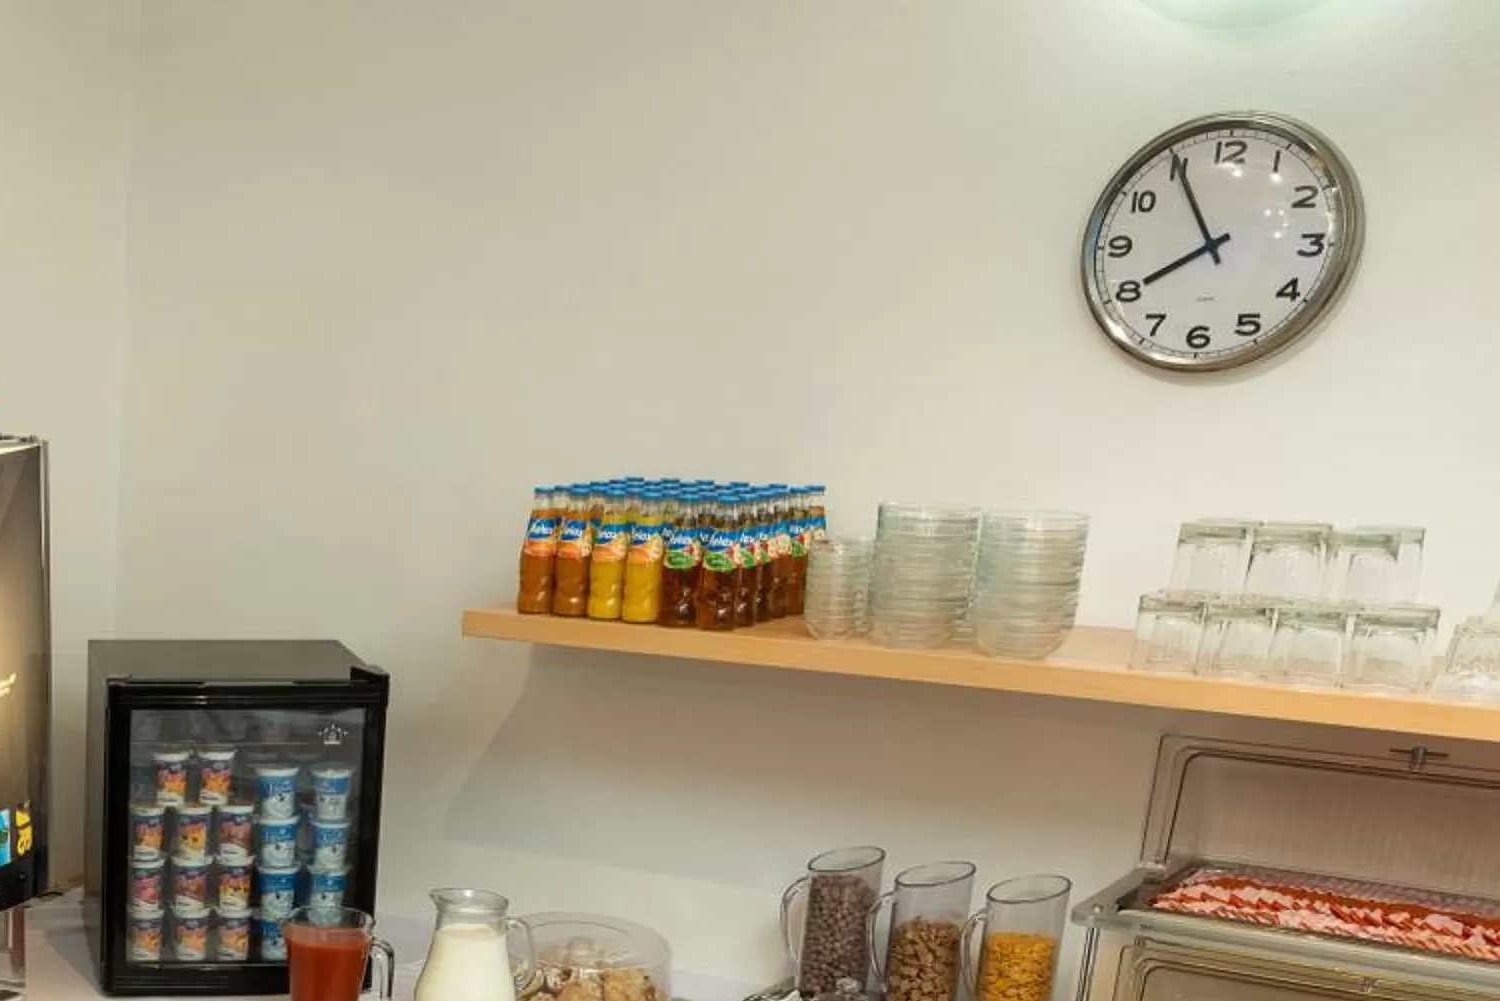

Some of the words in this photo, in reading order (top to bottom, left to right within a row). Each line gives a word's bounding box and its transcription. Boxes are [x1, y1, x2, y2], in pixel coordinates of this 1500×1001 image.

[1213, 141, 1248, 165] 12
[1272, 150, 1282, 174] 1
[1169, 154, 1188, 182] 11
[1131, 191, 1157, 213] 10
[1291, 186, 1319, 209] 2
[1108, 236, 1133, 258] 9
[1297, 233, 1326, 257] 3
[1115, 281, 1142, 303] 8
[1275, 278, 1301, 301] 4
[1145, 314, 1167, 337] 7
[1234, 313, 1262, 336] 5
[1186, 326, 1211, 349] 6
